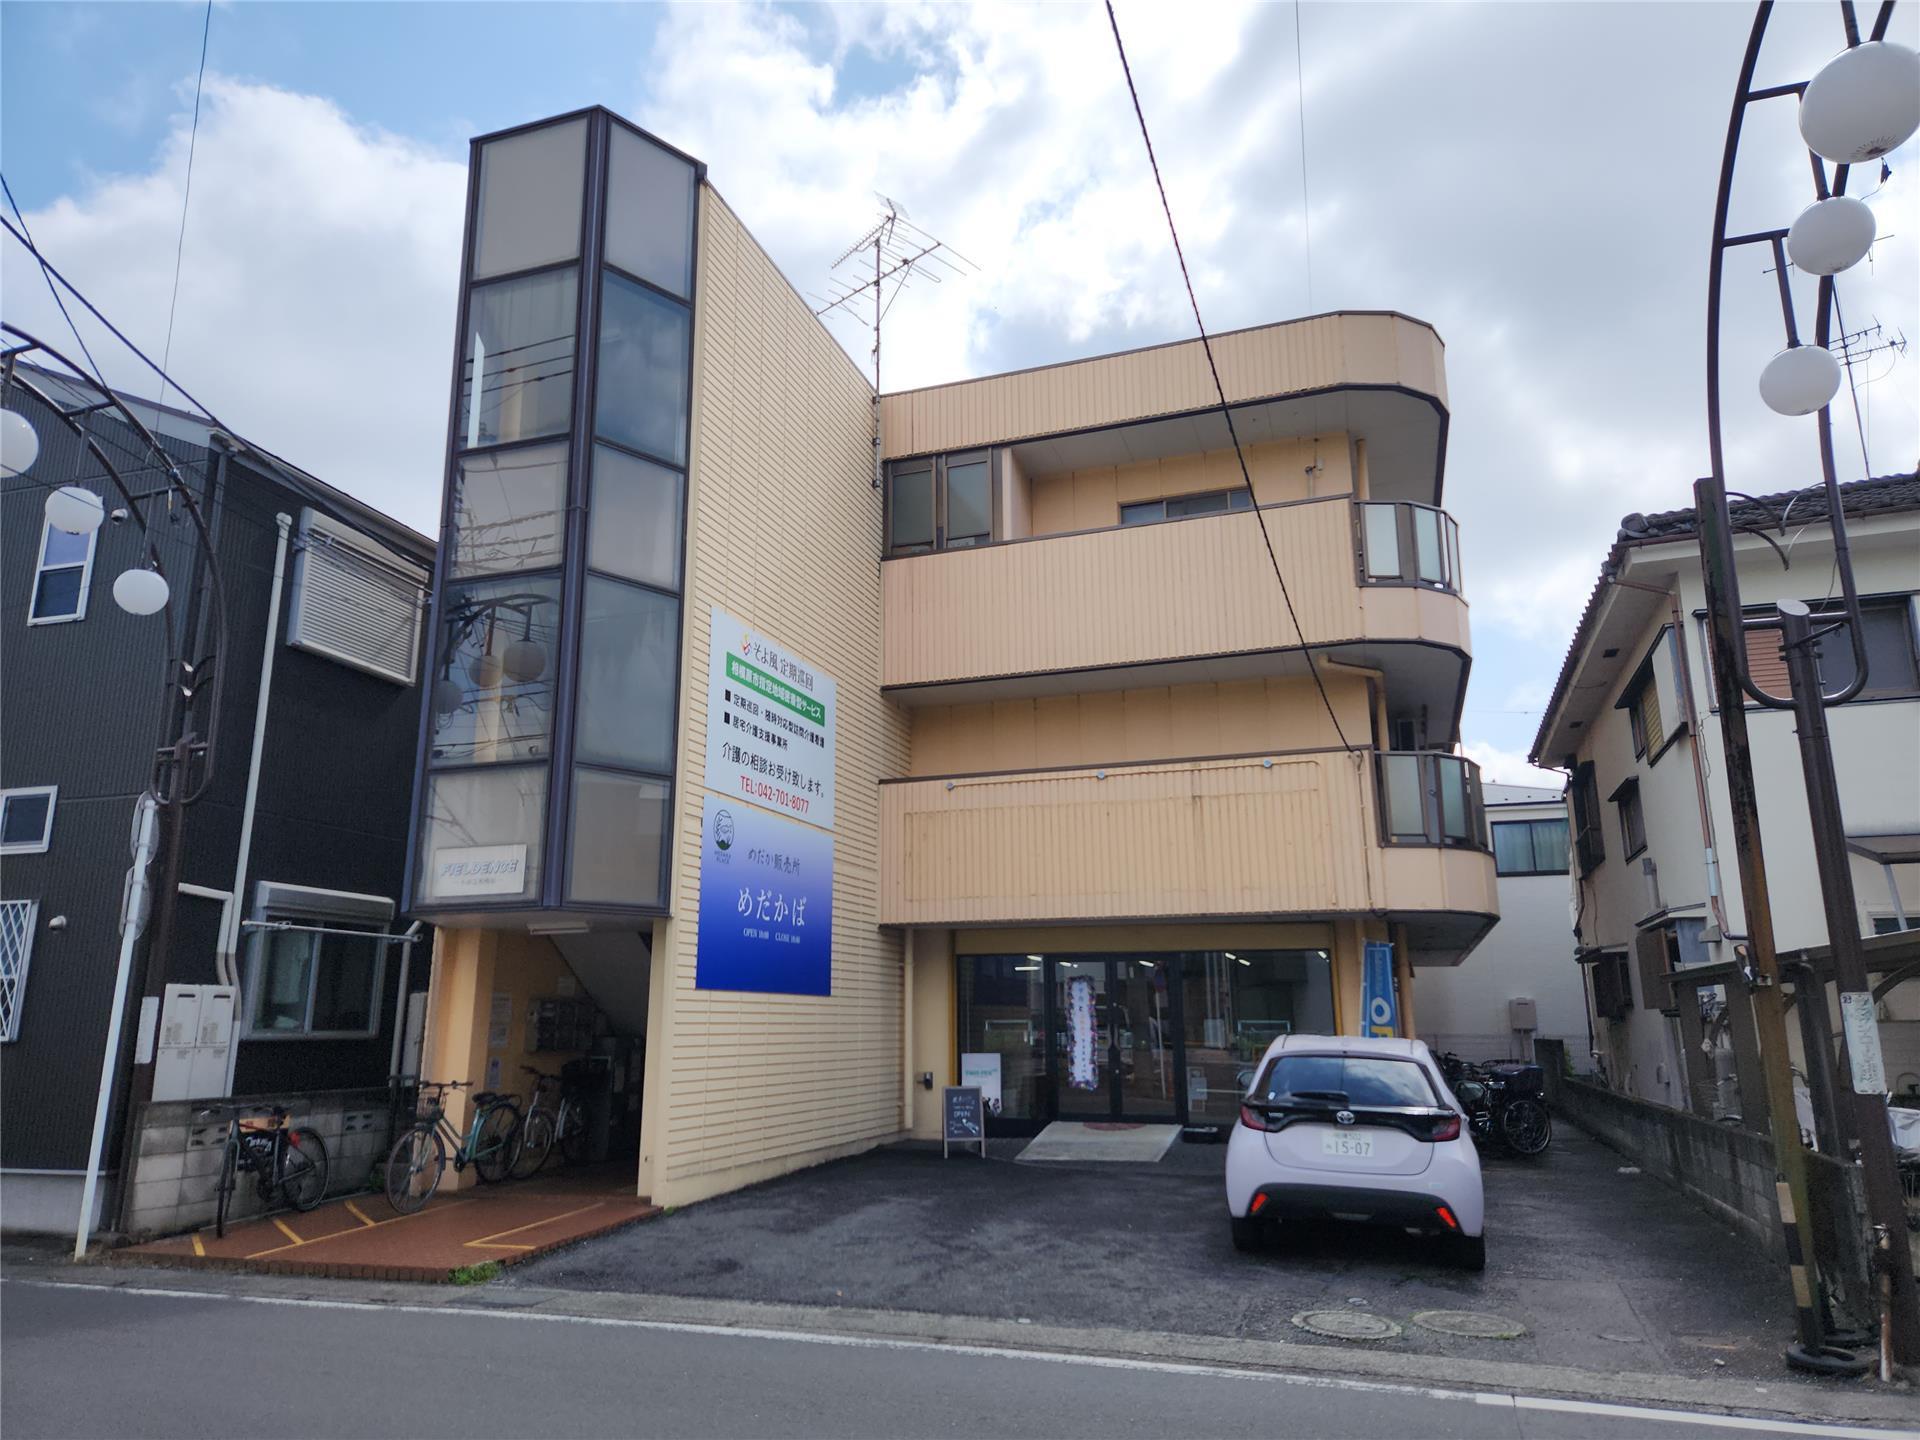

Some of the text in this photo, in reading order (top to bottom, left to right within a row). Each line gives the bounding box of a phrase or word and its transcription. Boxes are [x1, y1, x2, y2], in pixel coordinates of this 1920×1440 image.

[753, 644, 814, 693] そよ風 定期巡回
[722, 742, 824, 798] 介護の相談お受け致します。
[740, 775, 809, 814] TEL:042-701-8077
[748, 847, 801, 876] めだか販売所
[1335, 1140, 1371, 1155] 15-07
